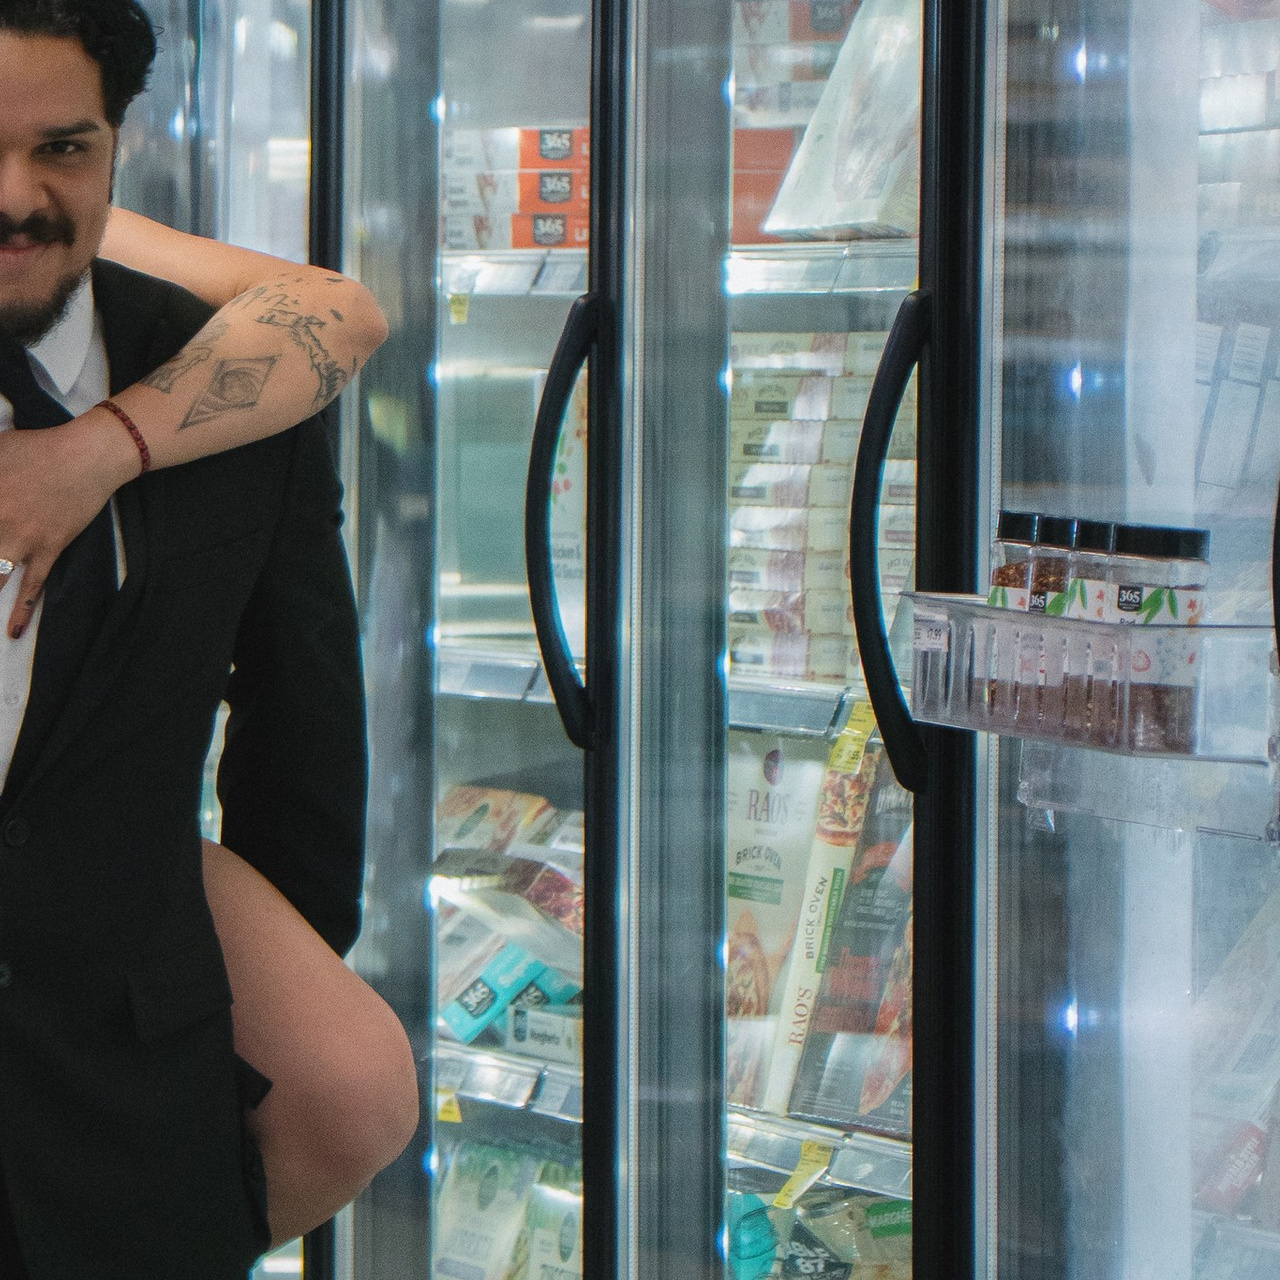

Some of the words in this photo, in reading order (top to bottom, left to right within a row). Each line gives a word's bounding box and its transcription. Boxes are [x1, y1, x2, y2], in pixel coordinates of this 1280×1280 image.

[542, 132, 571, 149] 365
[542, 175, 571, 192] 365
[536, 217, 565, 234] 365
[1029, 594, 1046, 609] 365
[1120, 589, 1141, 603] 365
[735, 845, 762, 867] BRICK
[808, 876, 829, 914] OVEN
[805, 918, 815, 960] BRICK
[461, 981, 490, 1012] 365
[787, 986, 813, 1046] RAO'S
[796, 1258, 825, 1274] 87
